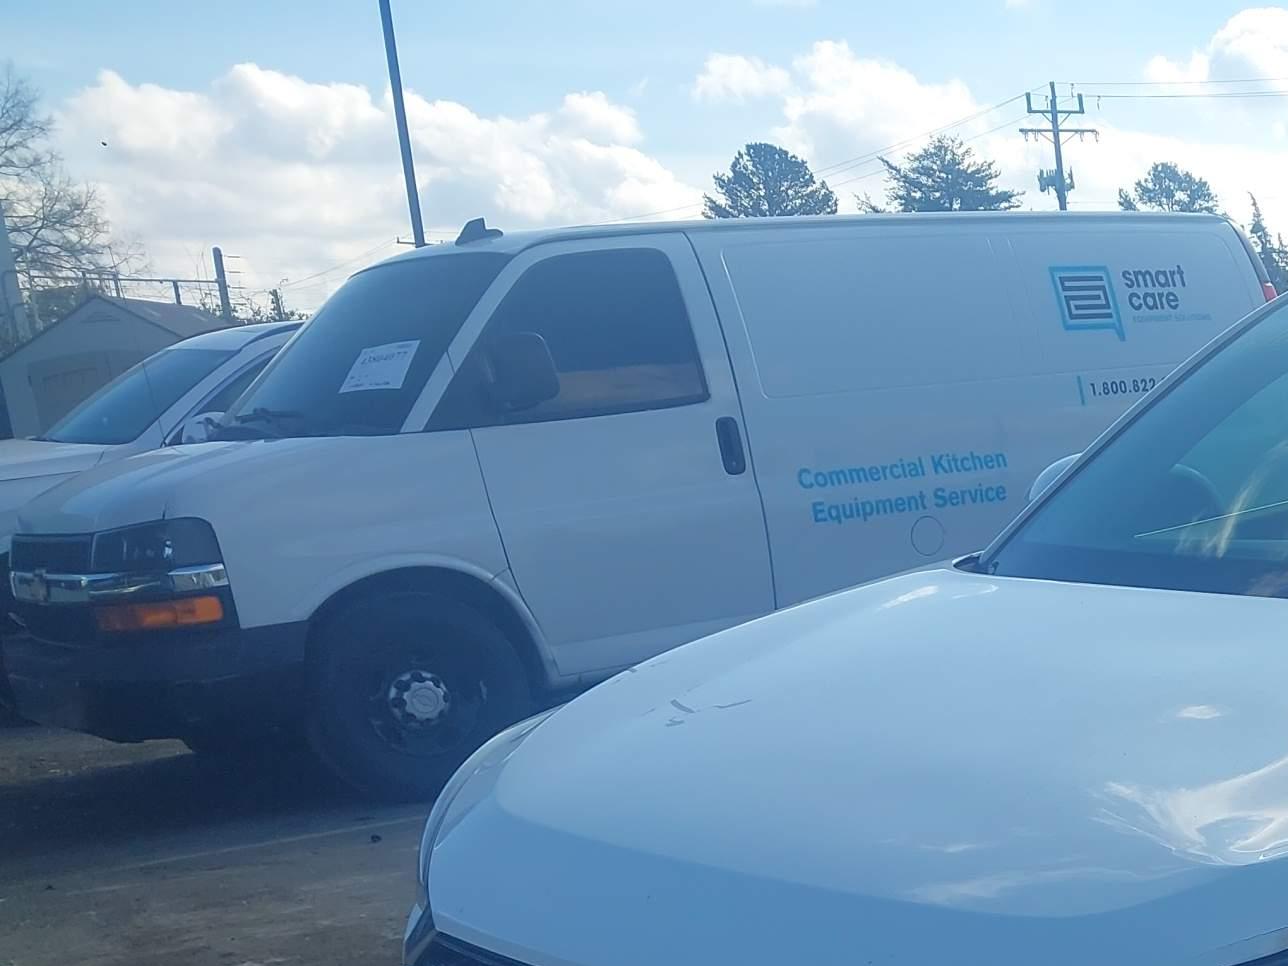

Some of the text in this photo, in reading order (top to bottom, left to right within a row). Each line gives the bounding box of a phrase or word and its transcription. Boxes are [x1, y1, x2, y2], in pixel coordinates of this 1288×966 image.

[1121, 264, 1186, 289] smart
[1128, 291, 1180, 311] care
[1089, 376, 1164, 397] 1.800.822
[797, 451, 1008, 489] Commercial Kitchen
[811, 483, 1008, 524] Equipment Service
